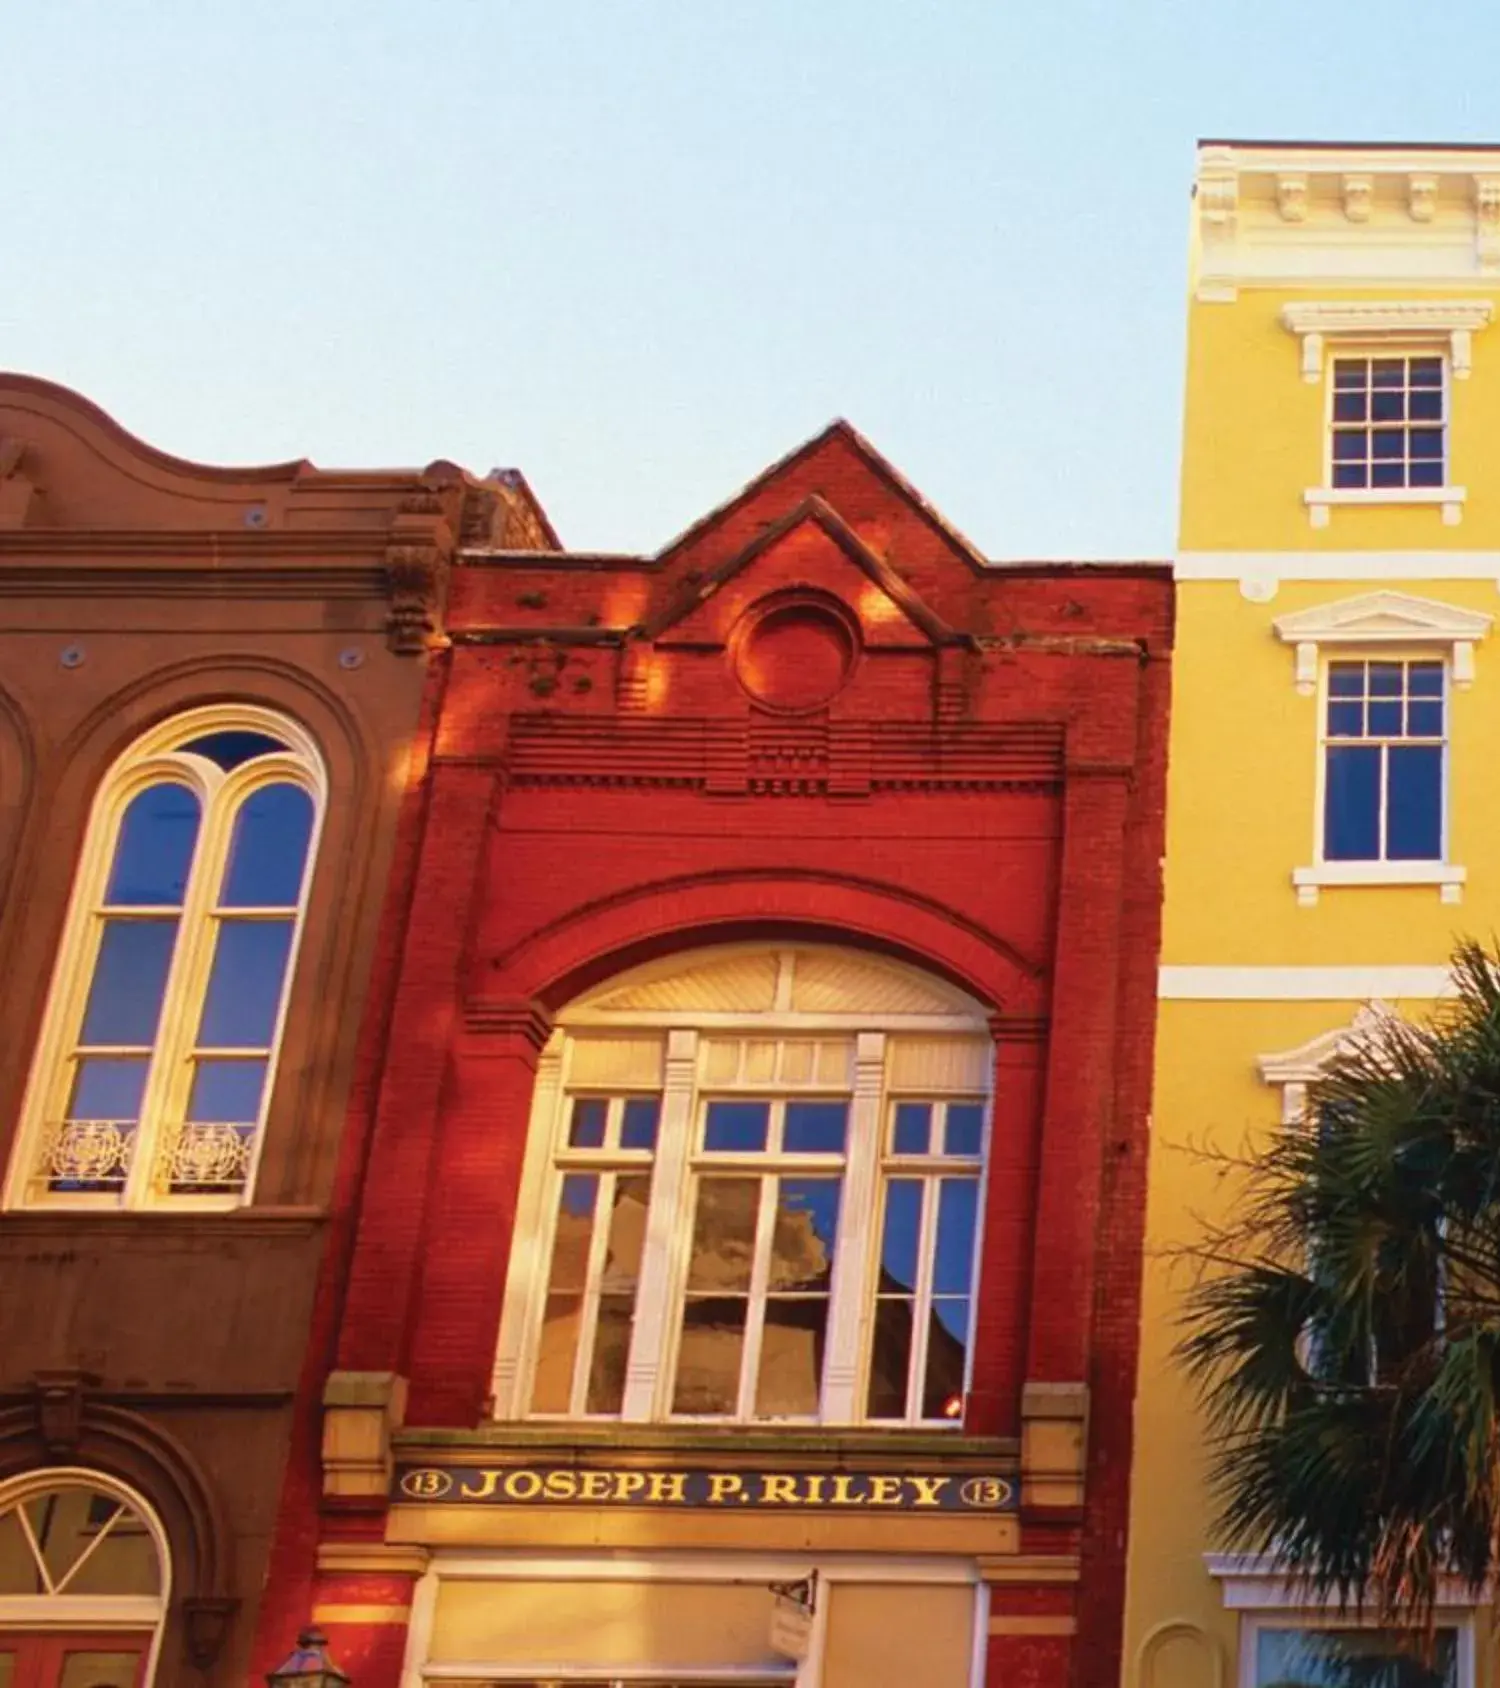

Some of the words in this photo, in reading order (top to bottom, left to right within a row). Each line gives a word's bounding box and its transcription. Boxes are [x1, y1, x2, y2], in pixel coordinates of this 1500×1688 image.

[413, 1472, 439, 1494] 13
[460, 1470, 689, 1502] JOSEPH
[972, 1480, 1001, 1503] 13
